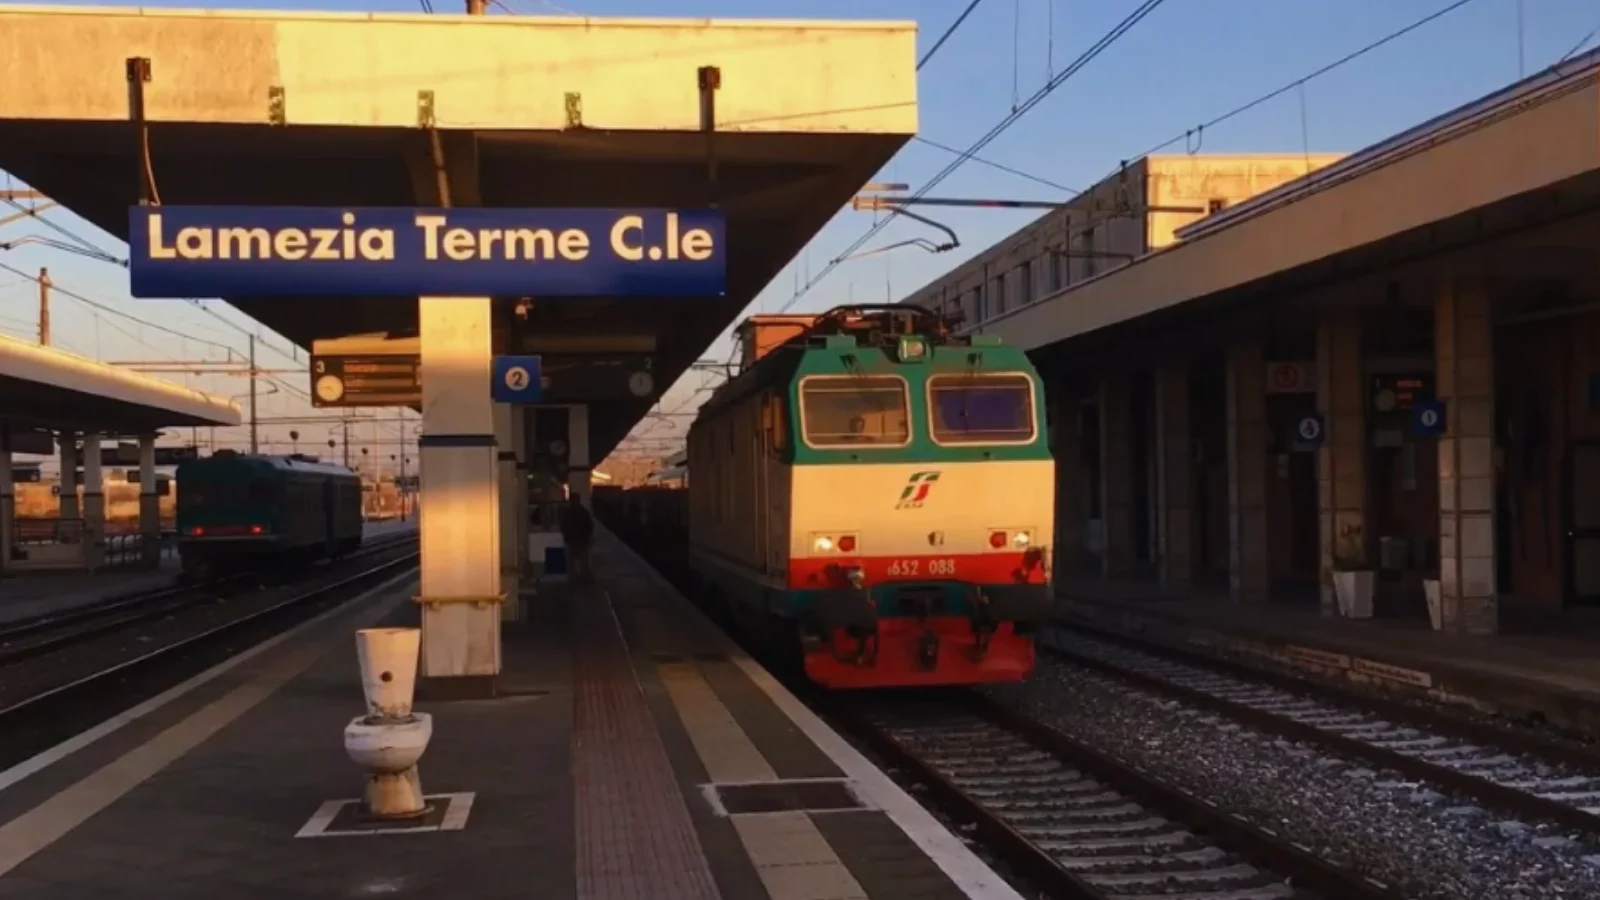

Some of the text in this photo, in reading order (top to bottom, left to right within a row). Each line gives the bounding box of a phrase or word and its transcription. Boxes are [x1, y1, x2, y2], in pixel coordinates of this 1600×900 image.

[147, 213, 714, 262] Lamezia Terme C.le
[316, 361, 325, 373] 3
[512, 372, 523, 387] 2
[928, 558, 956, 575] 088
